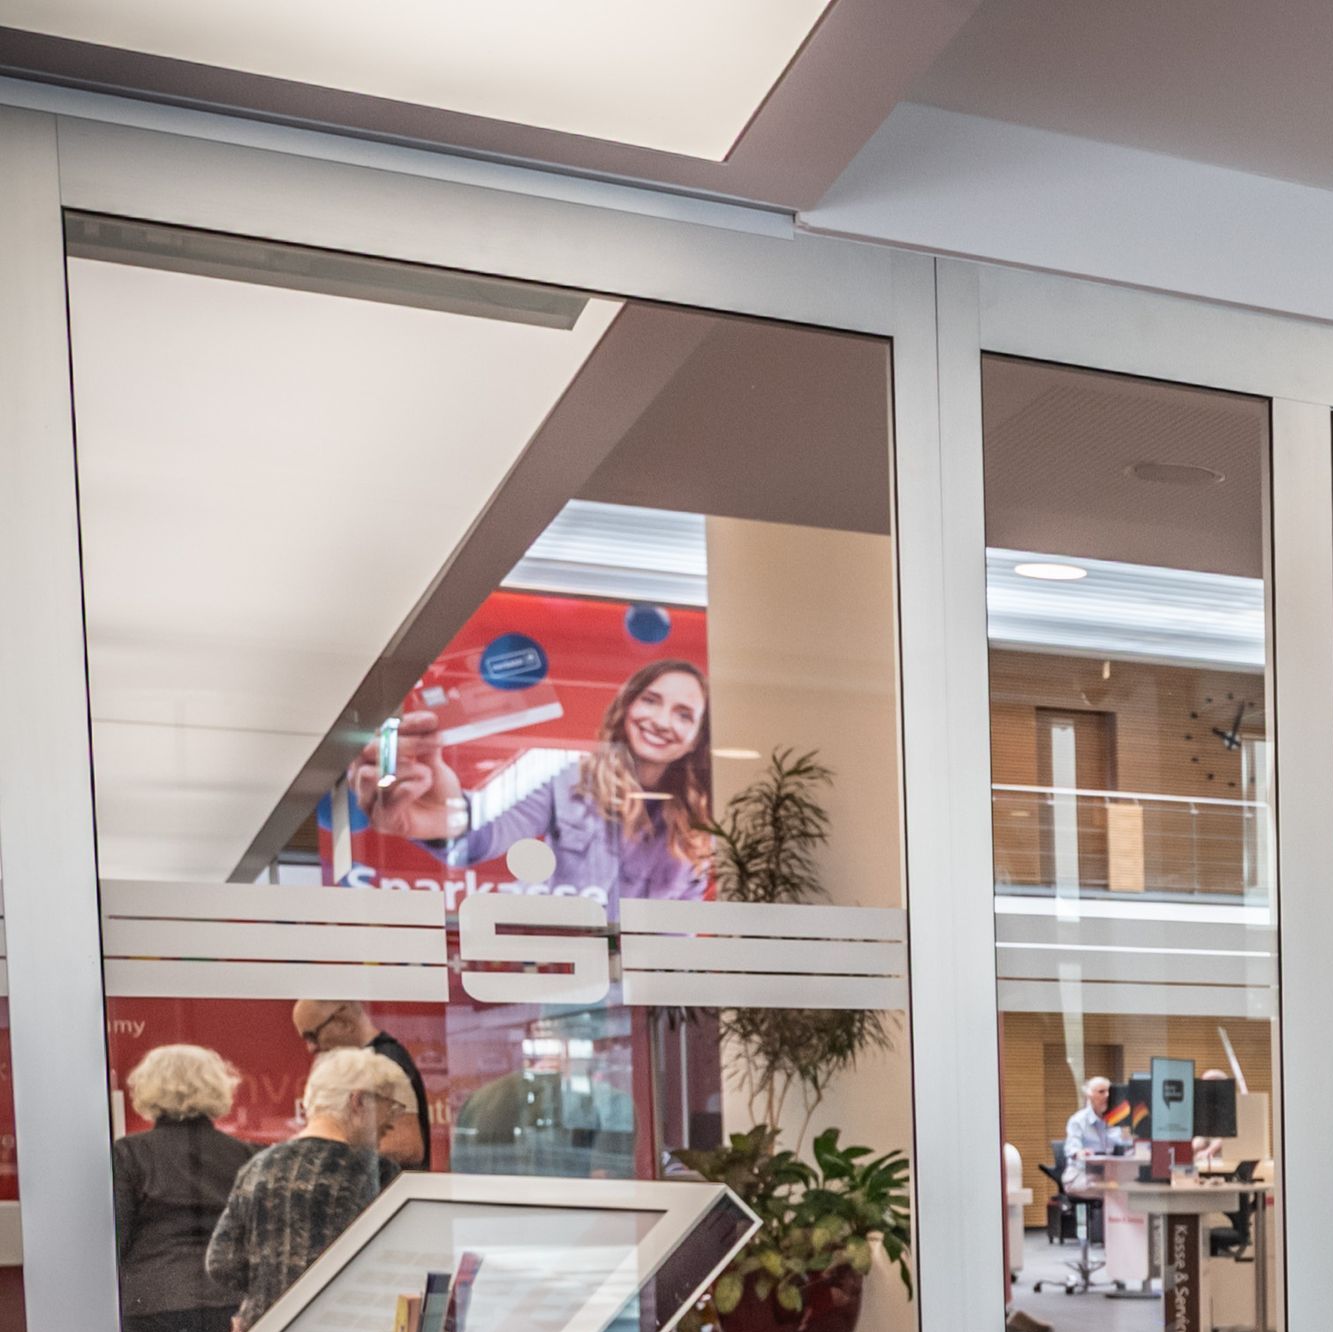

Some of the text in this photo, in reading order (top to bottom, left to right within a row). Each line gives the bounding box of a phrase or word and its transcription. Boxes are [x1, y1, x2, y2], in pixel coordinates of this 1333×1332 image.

[107, 1019, 146, 1039] my
[1174, 1224, 1188, 1269] Kasse
[1174, 1272, 1190, 1284] &
